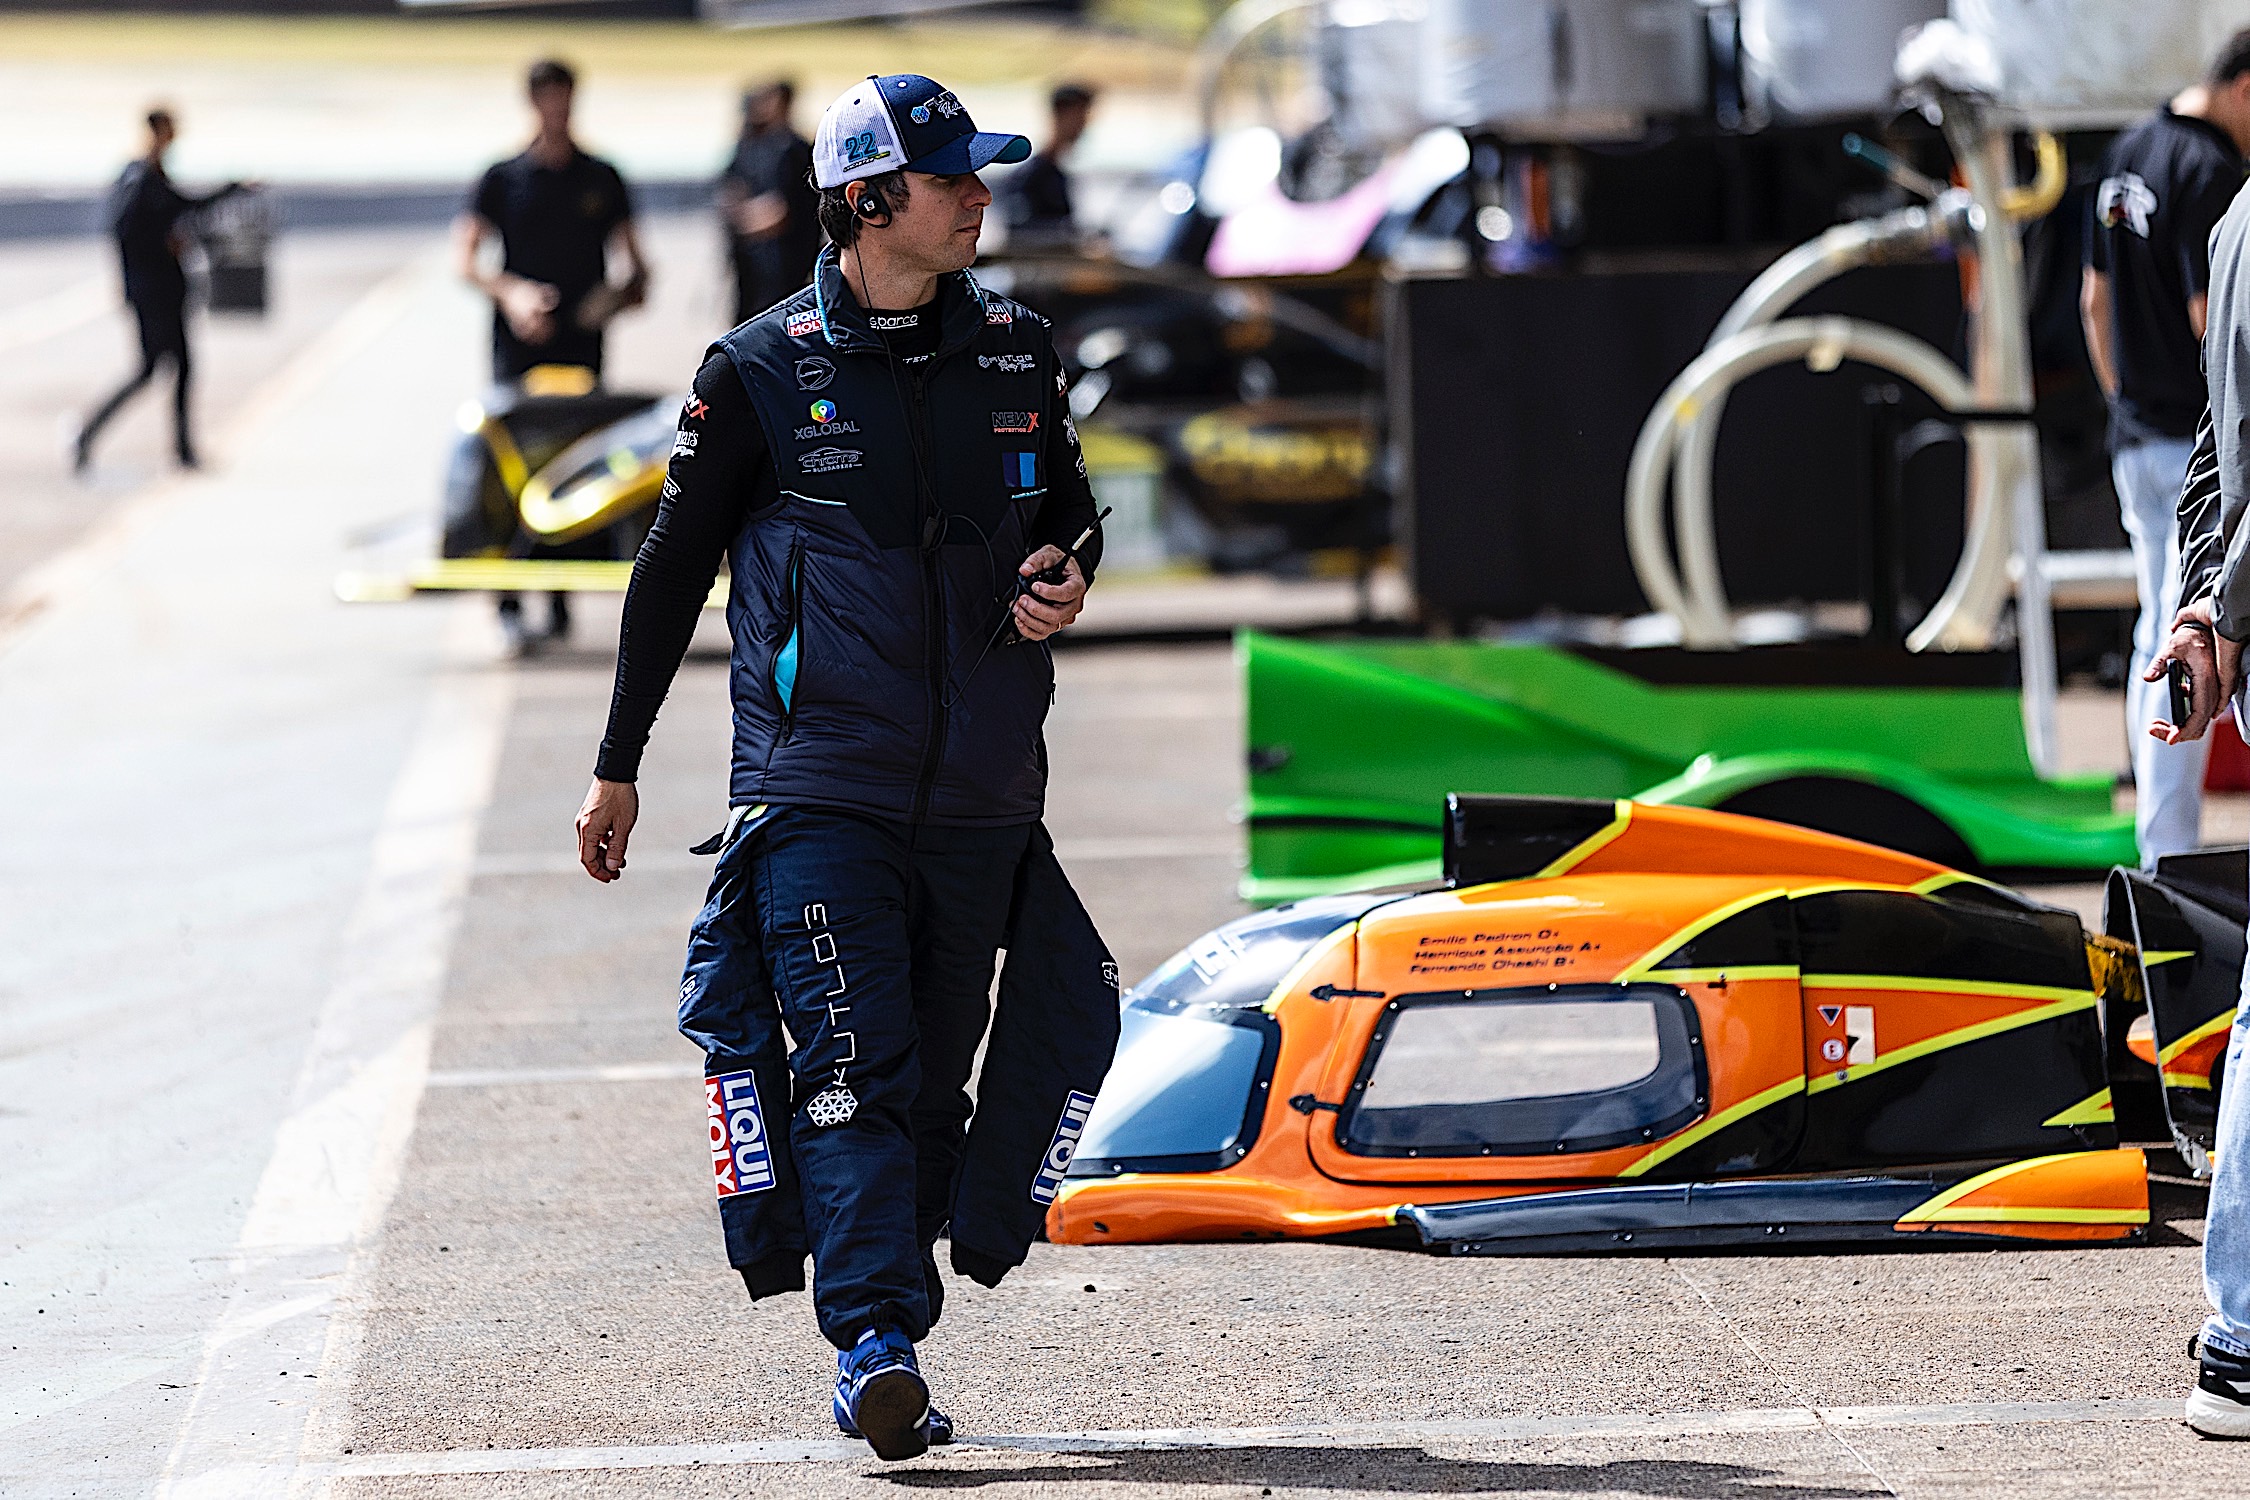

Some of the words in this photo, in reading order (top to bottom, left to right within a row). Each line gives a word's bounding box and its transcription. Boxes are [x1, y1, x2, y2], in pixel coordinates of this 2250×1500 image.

[844, 130, 878, 163] 22
[869, 315, 918, 330] sparco
[794, 421, 861, 440] XGLOBAL
[722, 1076, 770, 1188] LIQUI
[1034, 1098, 1093, 1199] LIQUI
